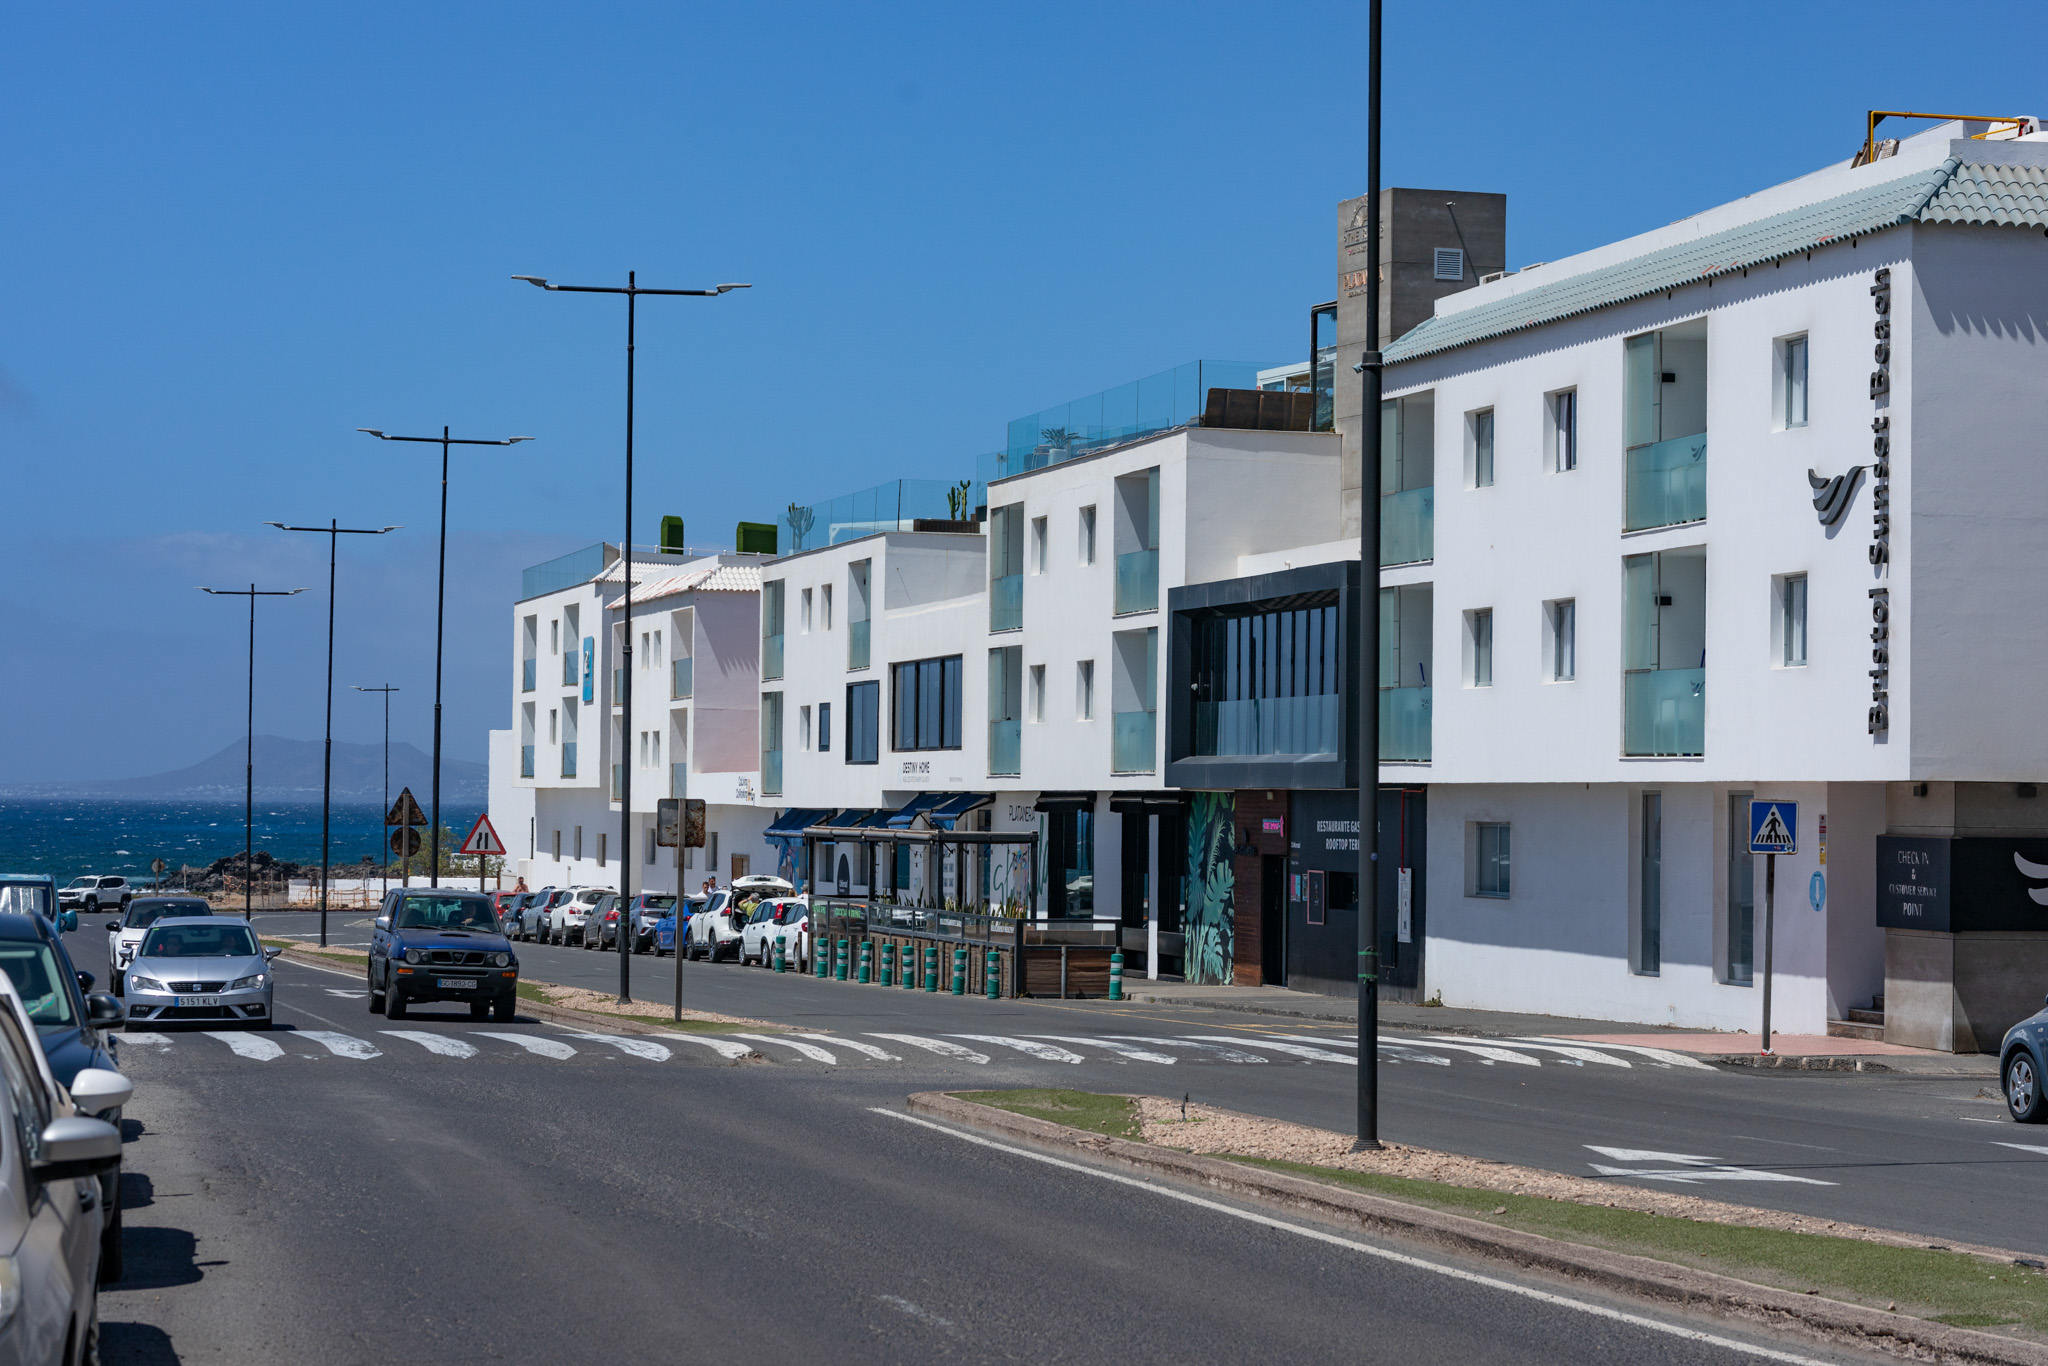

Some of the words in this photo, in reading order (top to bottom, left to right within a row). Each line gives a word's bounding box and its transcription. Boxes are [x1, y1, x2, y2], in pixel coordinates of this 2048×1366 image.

[1870, 268, 1890, 400] Beach
[1869, 416, 1889, 565] Sunset
[1868, 588, 1889, 735] Bristol
[903, 762, 918, 773] DESTINY
[919, 761, 930, 773] HOME
[1009, 805, 1035, 822] PLATANERA
[1317, 821, 1349, 832] RESTAURANTE
[1326, 839, 1348, 850] ROOFTOP
[1898, 851, 1920, 865] CHECK
[1889, 884, 1916, 896] CUSTOMER
[1917, 887, 1937, 897] SERVICE
[1903, 902, 1923, 916] POINT
[180, 997, 200, 1006] 5151
[202, 997, 218, 1006] KLV
